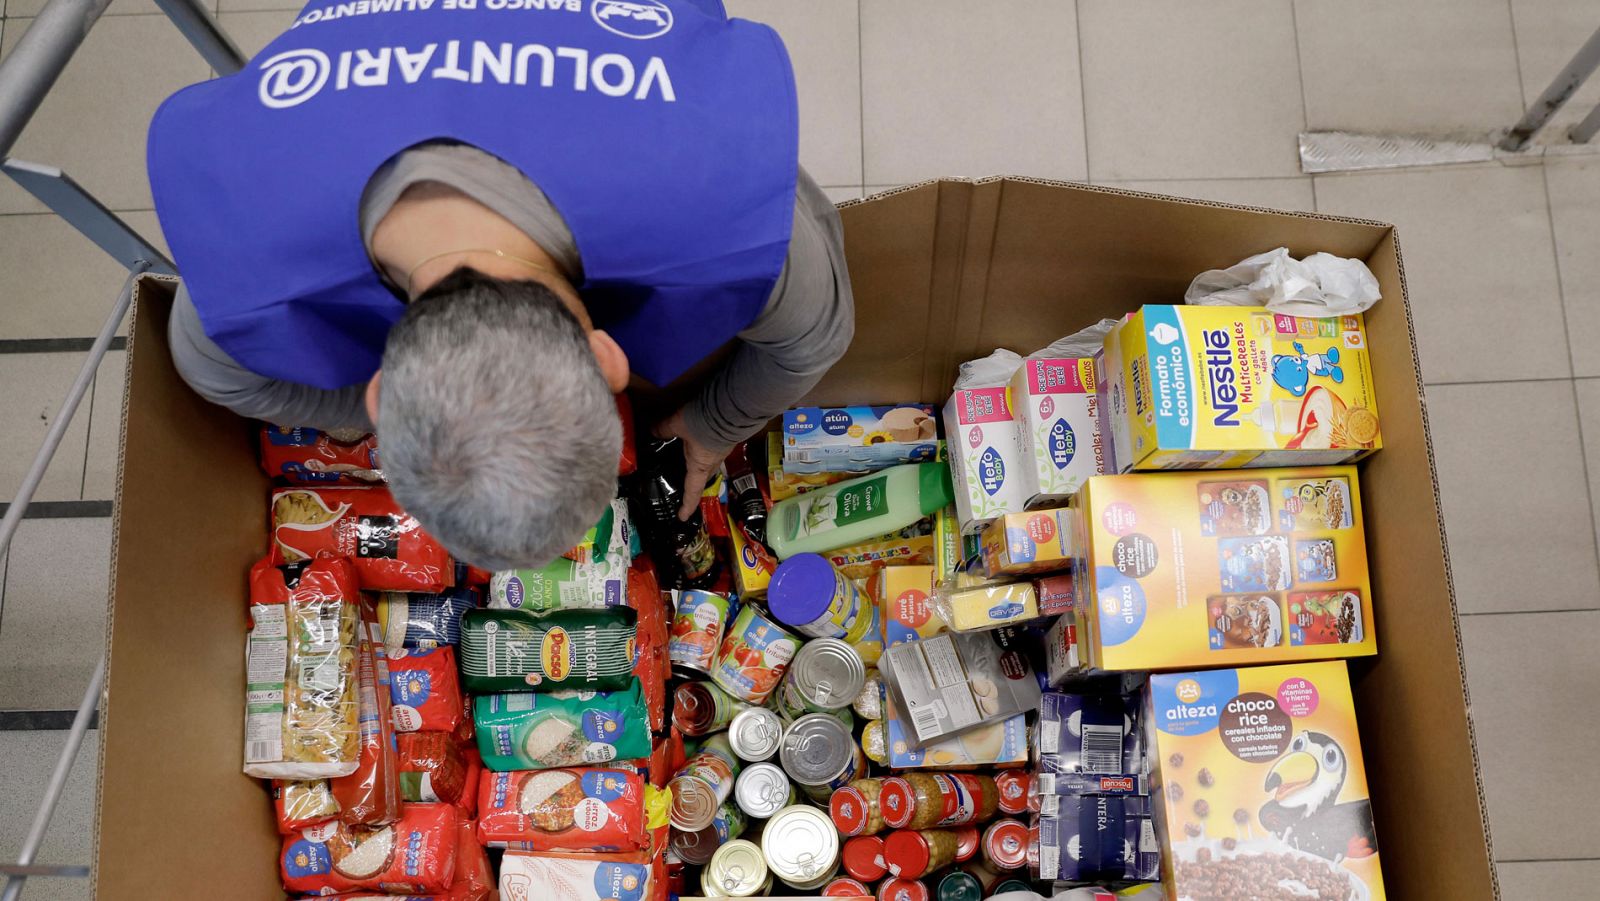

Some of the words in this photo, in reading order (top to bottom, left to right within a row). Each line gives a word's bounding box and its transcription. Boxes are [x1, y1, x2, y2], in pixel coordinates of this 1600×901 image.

[258, 40, 676, 108] VOLUNTARI@
[1347, 334, 1360, 346] 6
[1084, 360, 1095, 390] REGALOS
[1157, 355, 1173, 417] Formato
[1172, 346, 1189, 427] económico
[1203, 330, 1240, 427] Nestlé
[825, 413, 849, 423] atún
[1085, 394, 1097, 418] Miel
[1053, 423, 1067, 464] Hero
[1065, 429, 1074, 455] Baby
[983, 452, 997, 490] Hero
[994, 456, 1004, 482] Baby
[843, 493, 852, 517] Oliva
[865, 486, 873, 511] Crowe
[360, 517, 370, 556] GLO
[1117, 542, 1126, 573] choco
[1126, 547, 1135, 566] rice
[510, 581, 522, 604] Sidul
[531, 573, 543, 610] ZÚCAR
[899, 598, 908, 619] puré
[1124, 585, 1133, 623] alteza
[998, 628, 1009, 647] lteza
[569, 643, 577, 667] ARROZ
[585, 625, 598, 682] INTEGRAL
[1281, 688, 1313, 697] vitaminas
[1299, 680, 1305, 689] 8
[1227, 699, 1275, 713] choco
[1290, 694, 1311, 702] hierro
[402, 709, 414, 730] arroz
[1166, 704, 1217, 720] alteza
[1239, 713, 1268, 726] rice
[595, 714, 605, 739] alteza
[1224, 726, 1256, 736] cereales
[1256, 725, 1286, 733] inflados
[1231, 734, 1245, 743] con
[1245, 732, 1283, 742] chocolate
[1103, 781, 1131, 789] Pascual
[591, 803, 600, 828] arroz
[611, 866, 623, 898] alteza
